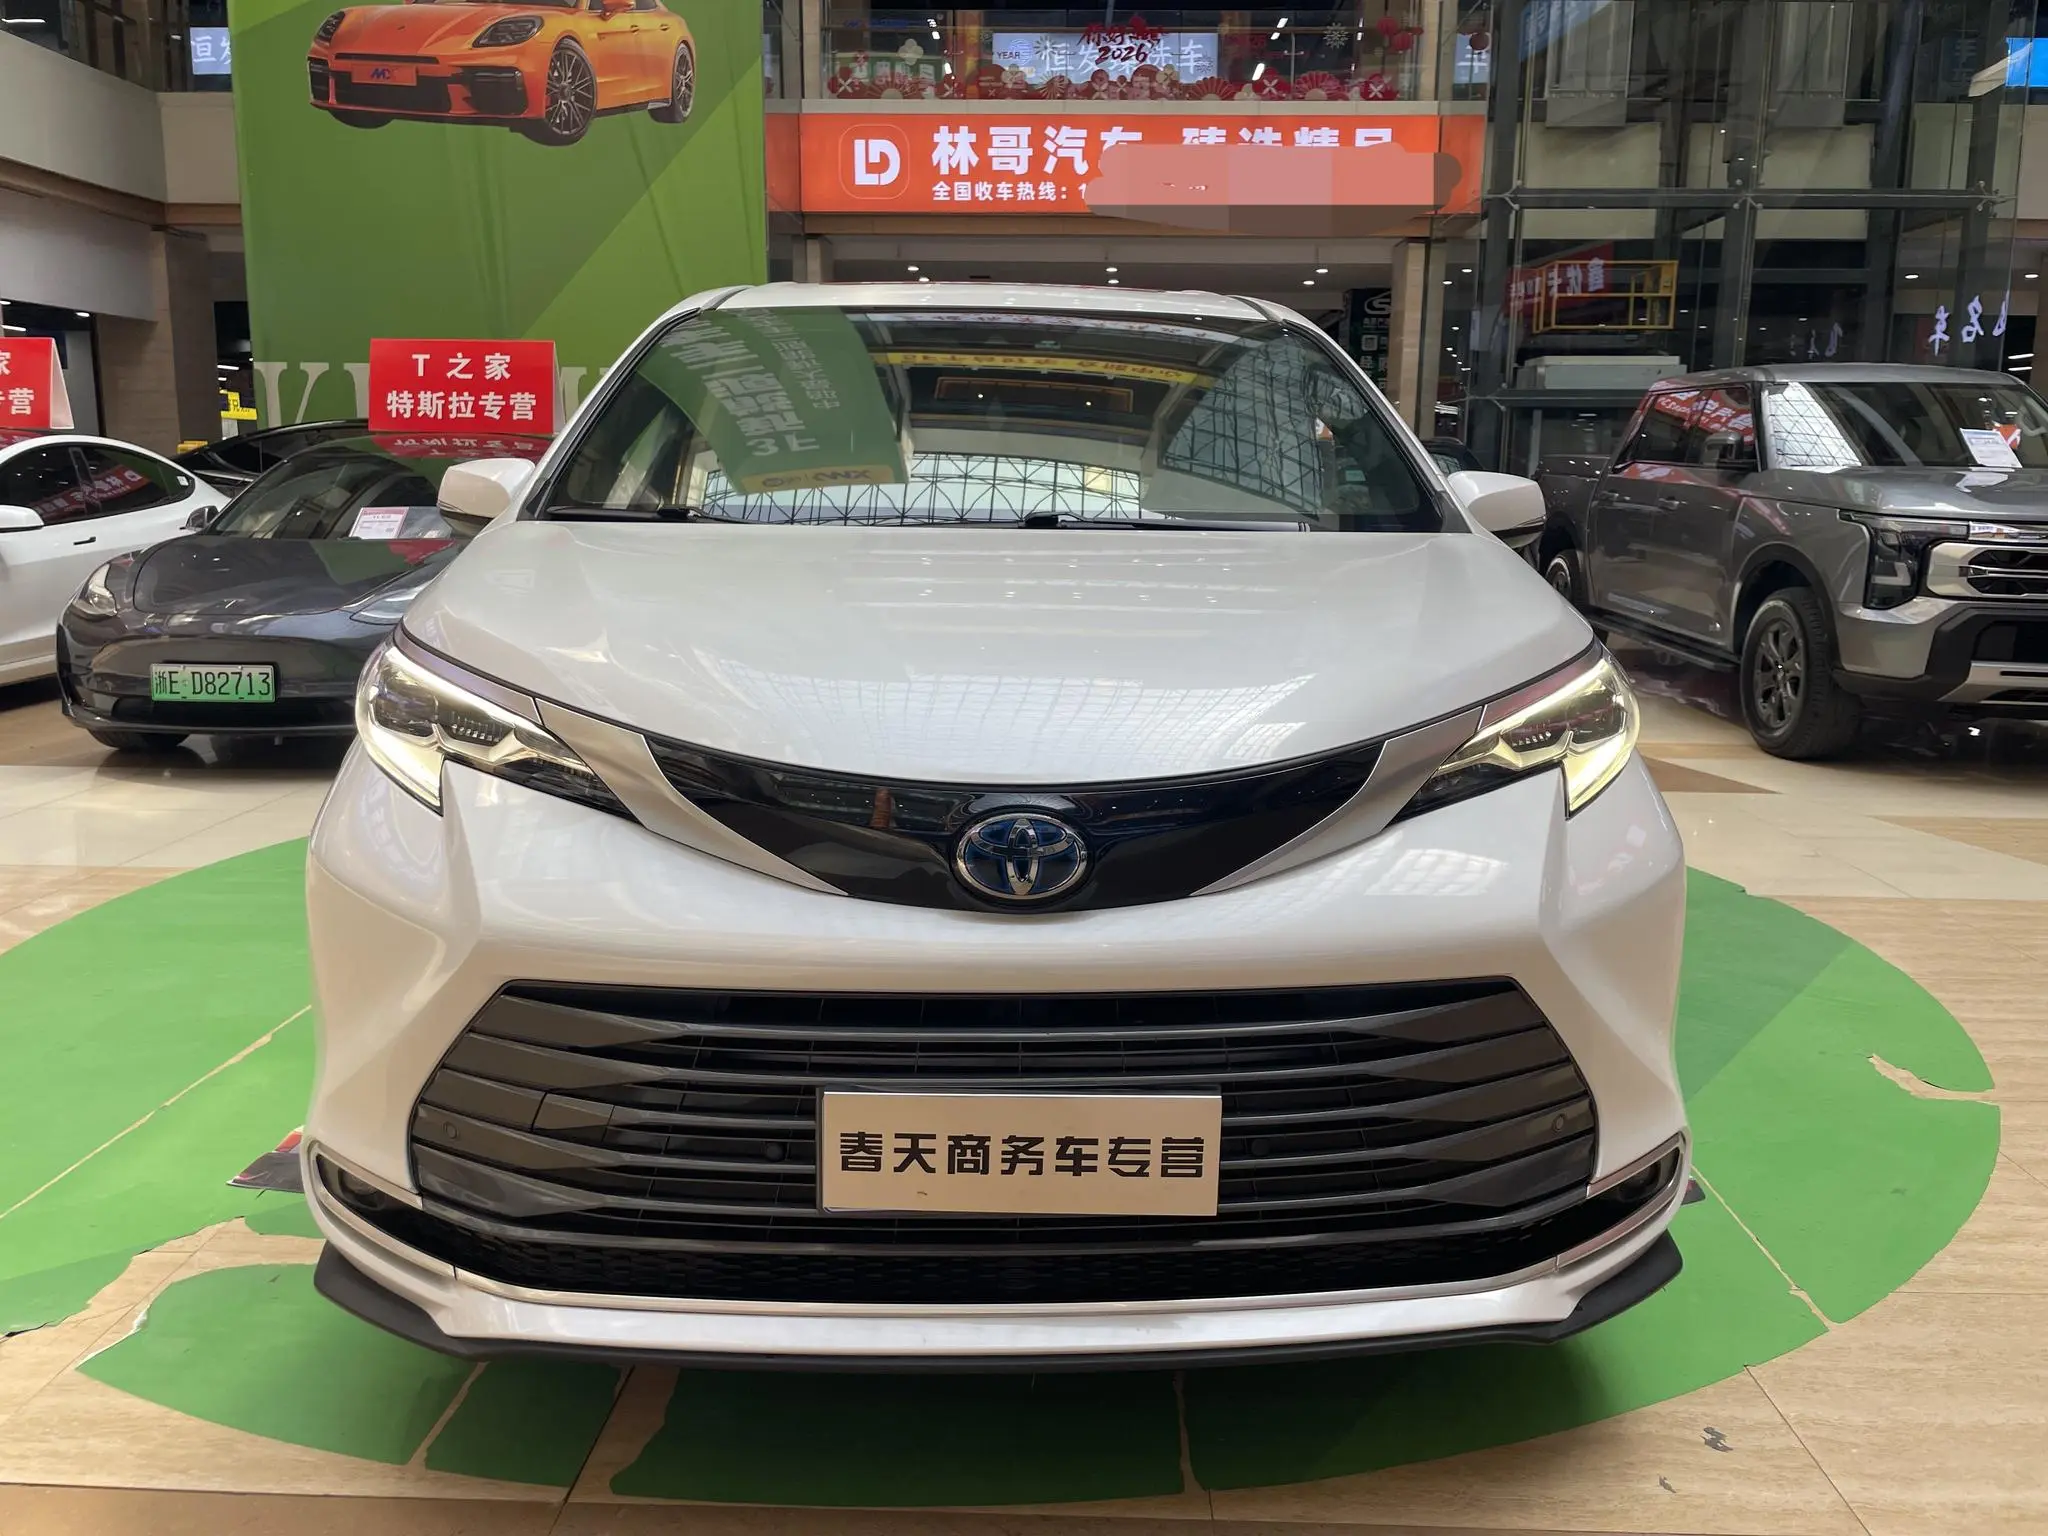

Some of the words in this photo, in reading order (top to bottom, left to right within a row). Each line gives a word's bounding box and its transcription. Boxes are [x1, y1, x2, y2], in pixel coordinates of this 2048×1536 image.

[997, 51, 1021, 60] YEAR
[1095, 43, 1148, 66] 2026
[0, 387, 35, 416] 营
[386, 390, 537, 421] 特斯拉专营
[191, 671, 271, 696] D82713
[839, 1131, 1205, 1178] 春天商务车专营
